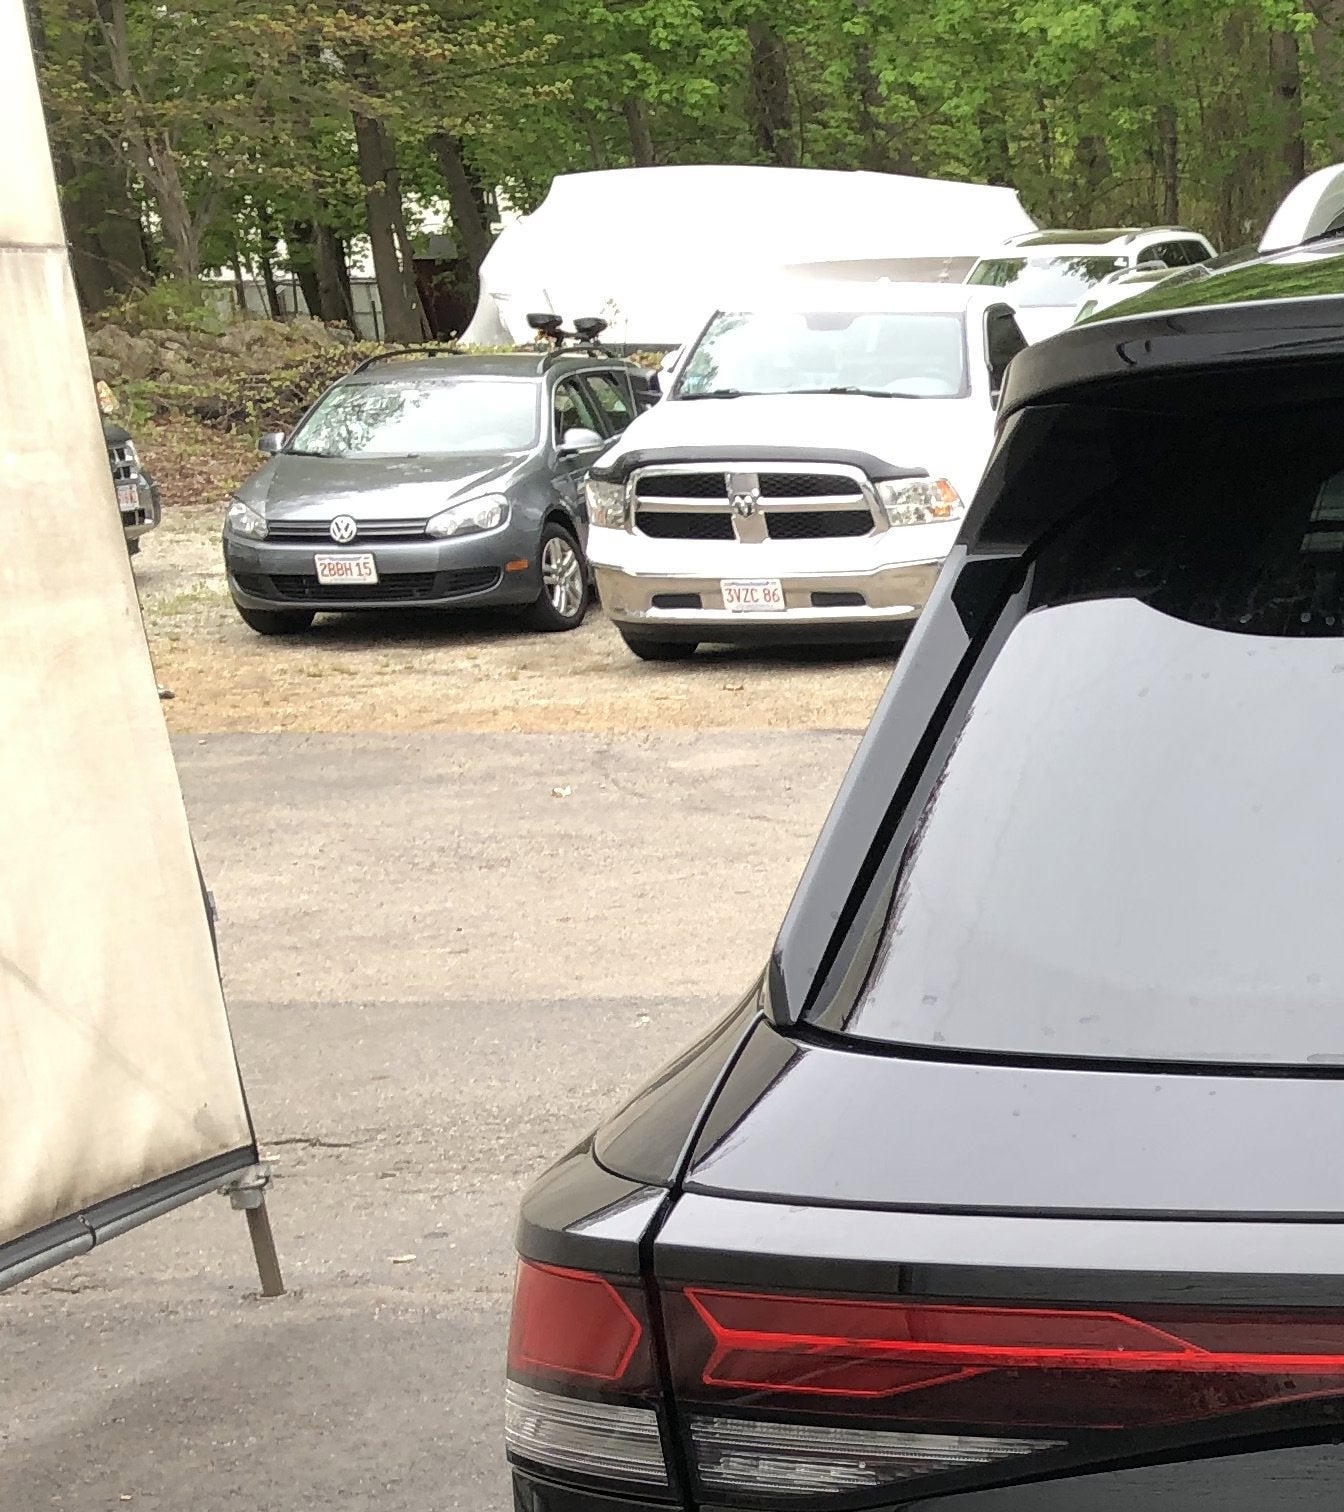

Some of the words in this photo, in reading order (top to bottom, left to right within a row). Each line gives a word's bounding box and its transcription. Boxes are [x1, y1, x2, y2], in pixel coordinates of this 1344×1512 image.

[319, 561, 353, 577] 2BBH
[355, 561, 372, 577] 15
[725, 587, 759, 603] 3VZC
[763, 587, 781, 603] 86
